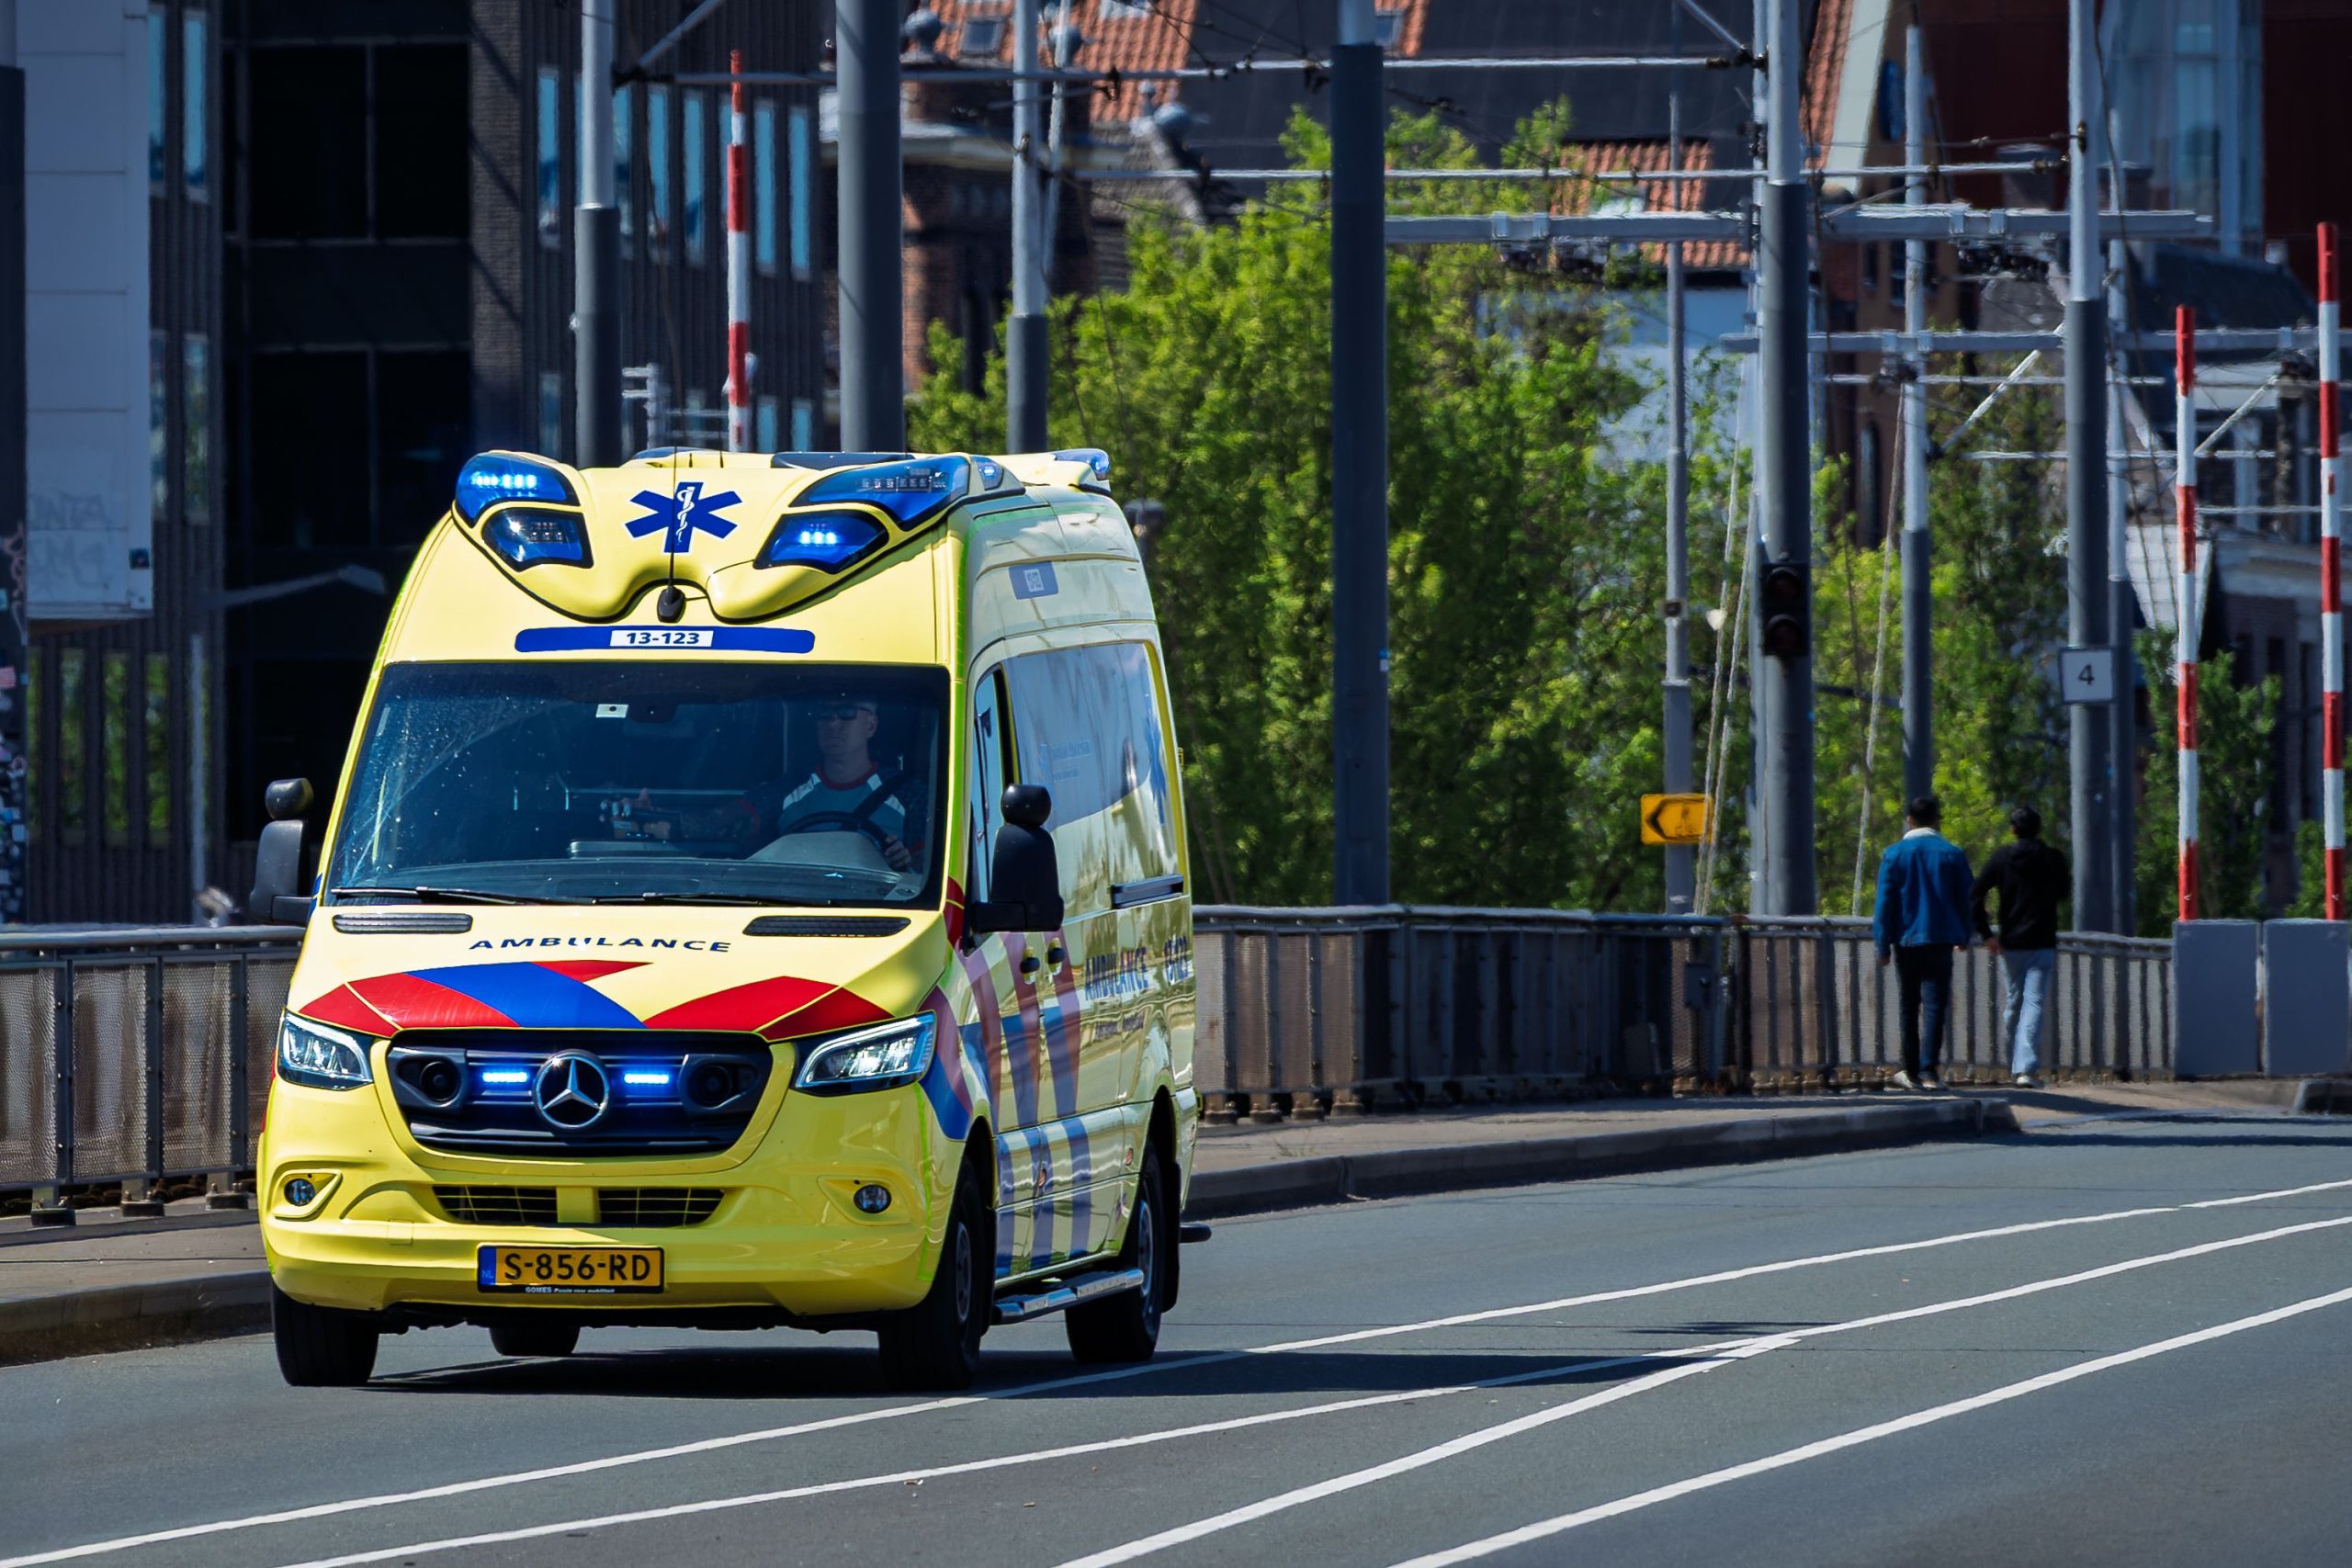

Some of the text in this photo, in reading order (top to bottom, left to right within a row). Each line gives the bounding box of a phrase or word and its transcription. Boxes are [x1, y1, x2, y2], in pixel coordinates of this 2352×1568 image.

[626, 632, 700, 645] 13-123
[2077, 664, 2095, 686] 4
[469, 937, 731, 953] AMBULANCE
[1084, 946, 1148, 1001] AMBULANCE
[481, 1269, 494, 1280] NL
[504, 1252, 650, 1281] S-856-RD
